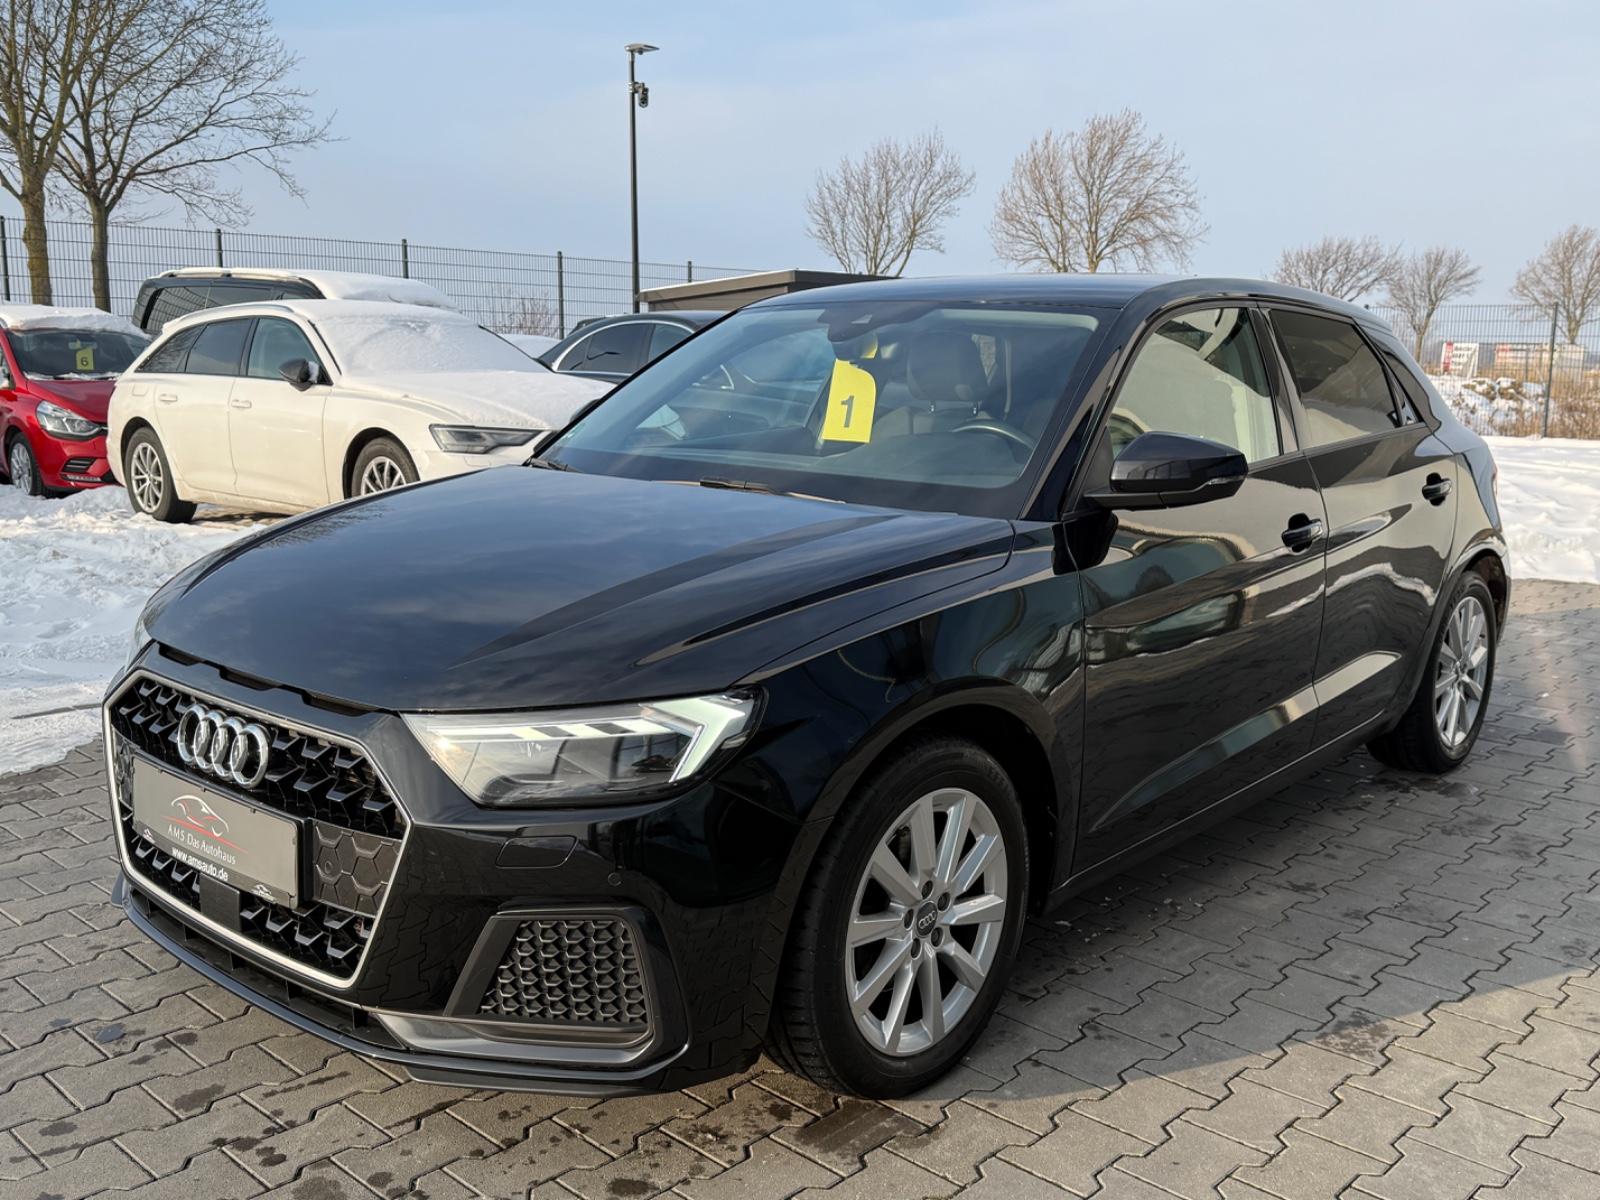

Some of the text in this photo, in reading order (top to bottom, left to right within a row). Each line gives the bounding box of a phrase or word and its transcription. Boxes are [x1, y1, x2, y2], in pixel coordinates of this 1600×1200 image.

[81, 357, 88, 366] 6
[841, 395, 855, 428] 1
[168, 824, 236, 865] AMS Das Autohaus
[172, 847, 228, 881] www.amsauto.de
